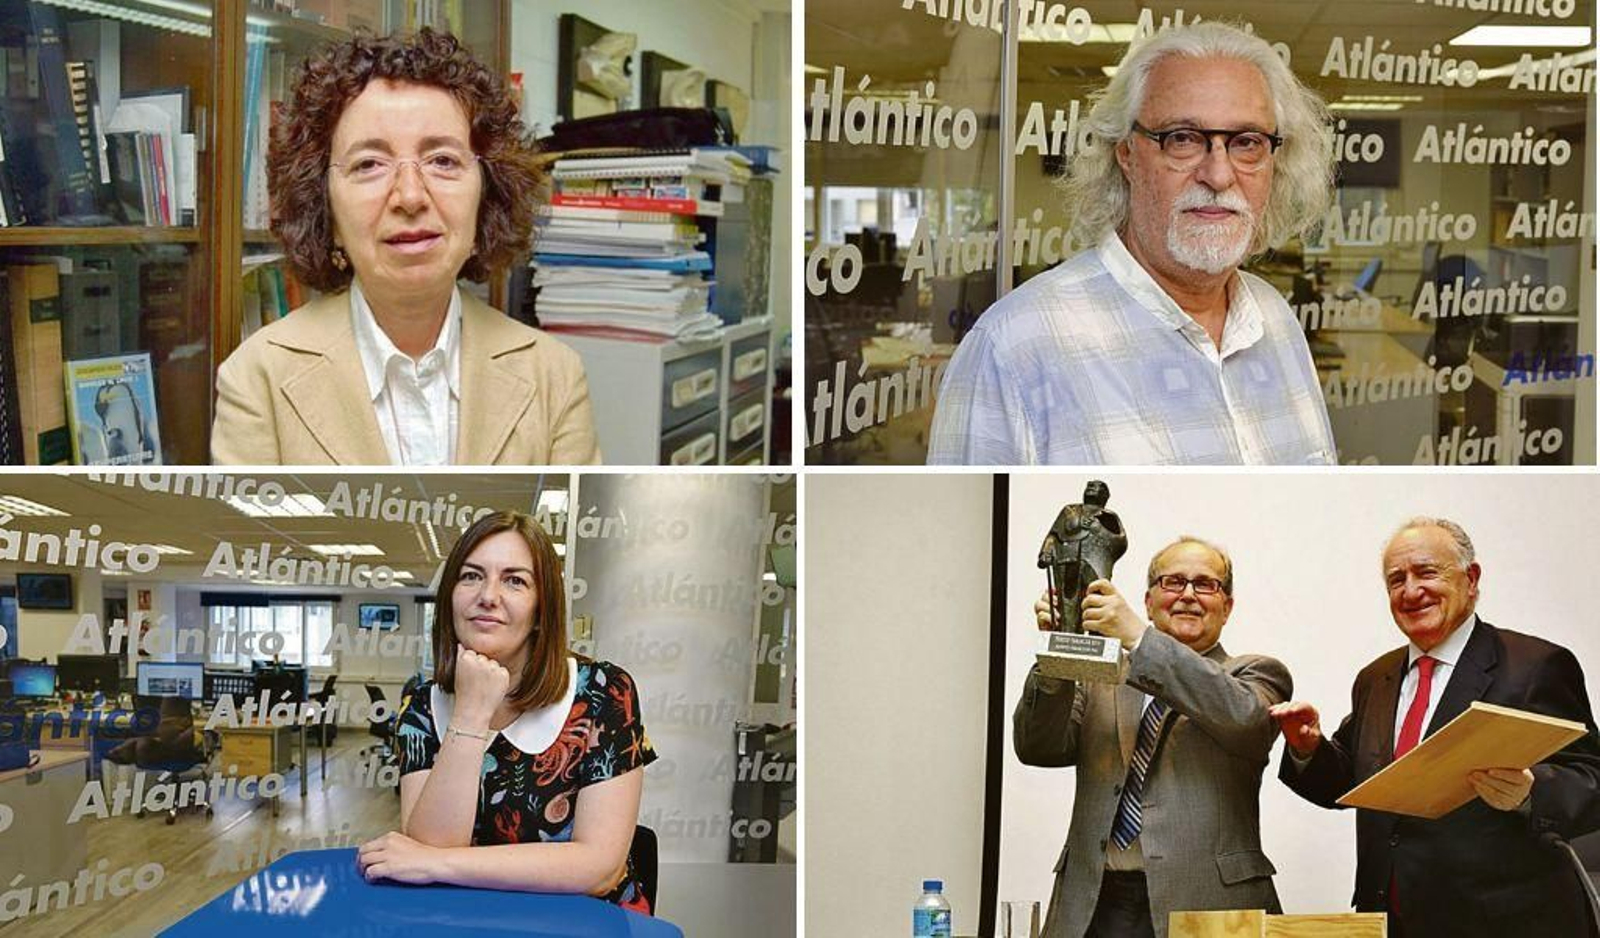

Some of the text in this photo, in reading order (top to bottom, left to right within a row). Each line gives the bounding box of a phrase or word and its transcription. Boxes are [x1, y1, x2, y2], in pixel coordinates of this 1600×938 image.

[1321, 36, 1479, 88] Atlántico
[804, 66, 977, 151] tlántico
[1414, 123, 1571, 166] Atlántico
[1319, 200, 1477, 246] Atlántico
[1412, 275, 1567, 322] Atlántico
[804, 356, 945, 450] tlánti
[1323, 355, 1475, 410] Atlántico
[202, 541, 395, 590] Atlántico
[64, 612, 285, 657] Atlántico
[204, 689, 393, 731] Atlántico
[66, 765, 286, 825] Atlántico
